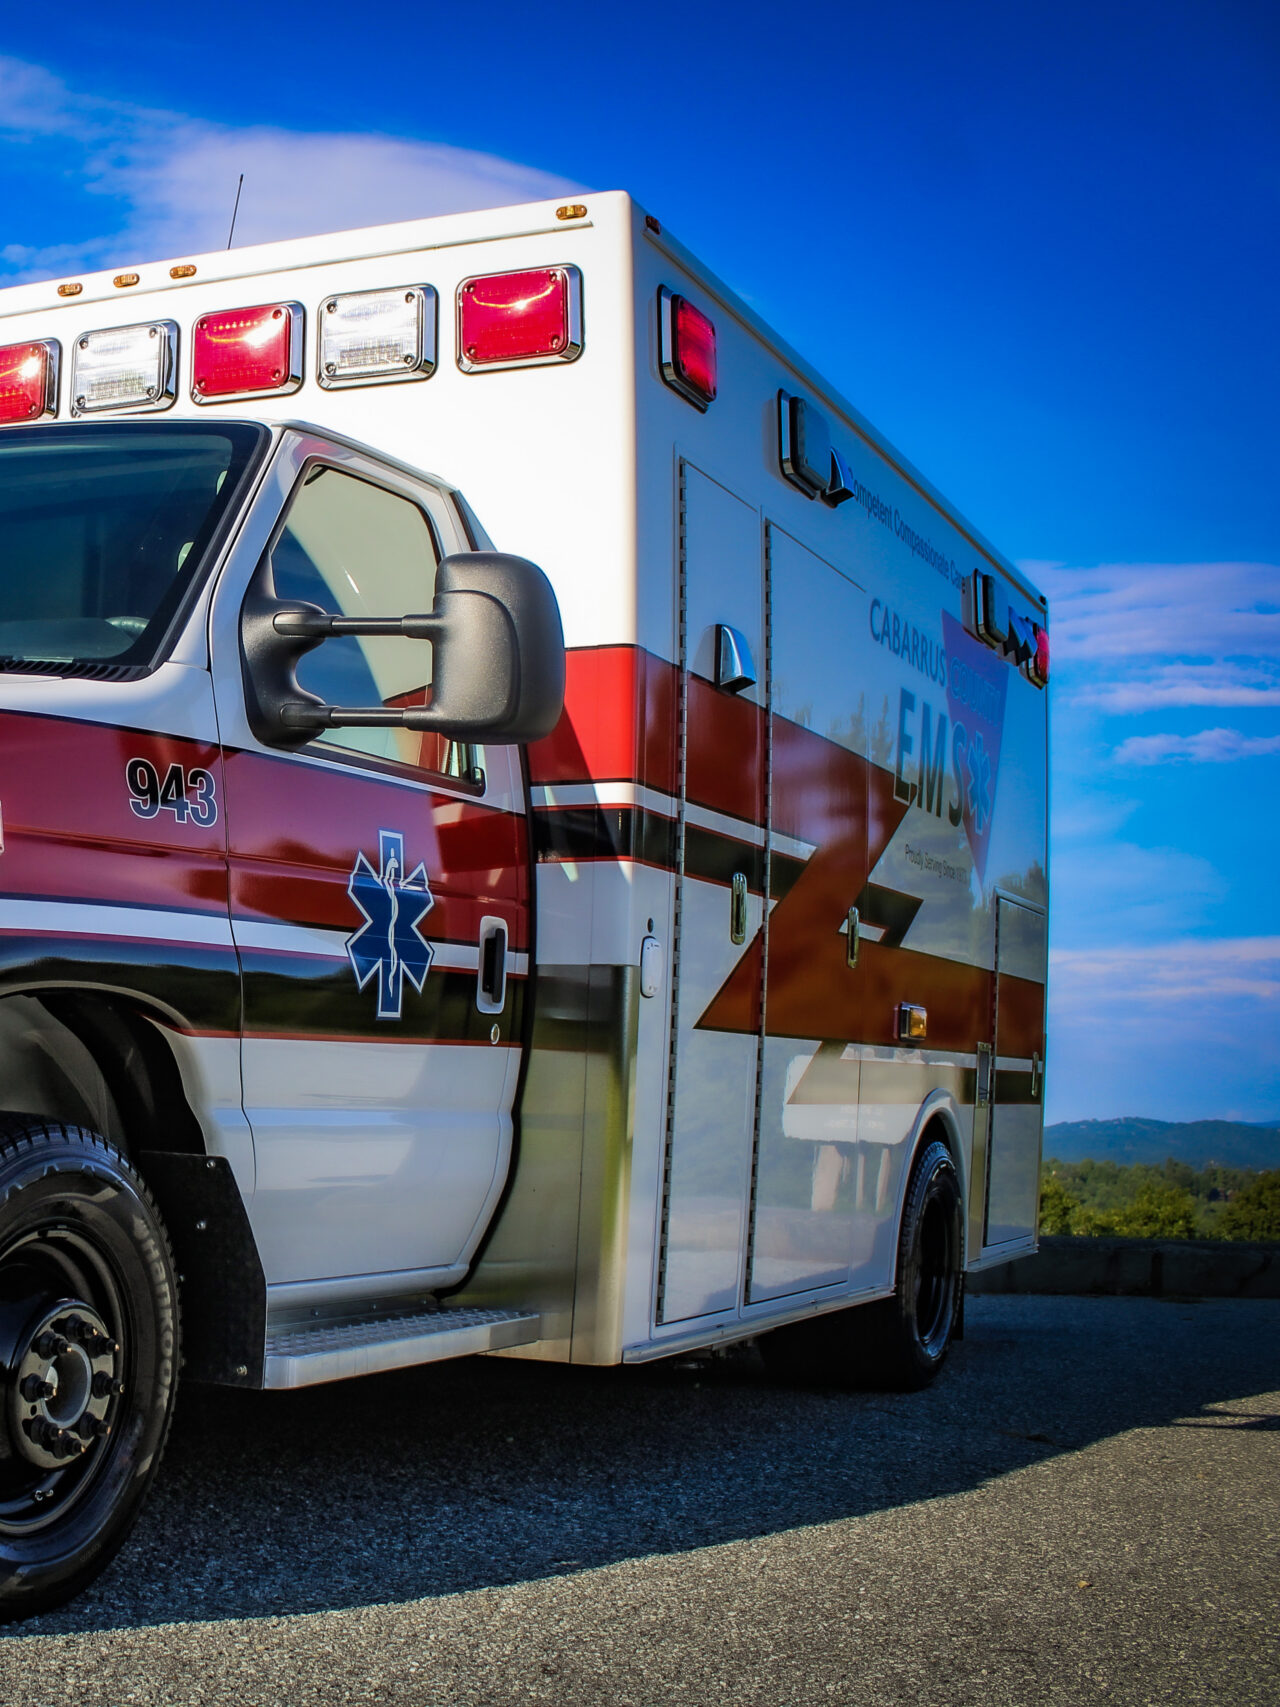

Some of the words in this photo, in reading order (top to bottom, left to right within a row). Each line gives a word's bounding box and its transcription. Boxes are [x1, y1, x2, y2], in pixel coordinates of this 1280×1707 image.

[870, 598, 946, 688] CABARRUS
[126, 757, 218, 827] 943
[894, 687, 967, 828] EMS
